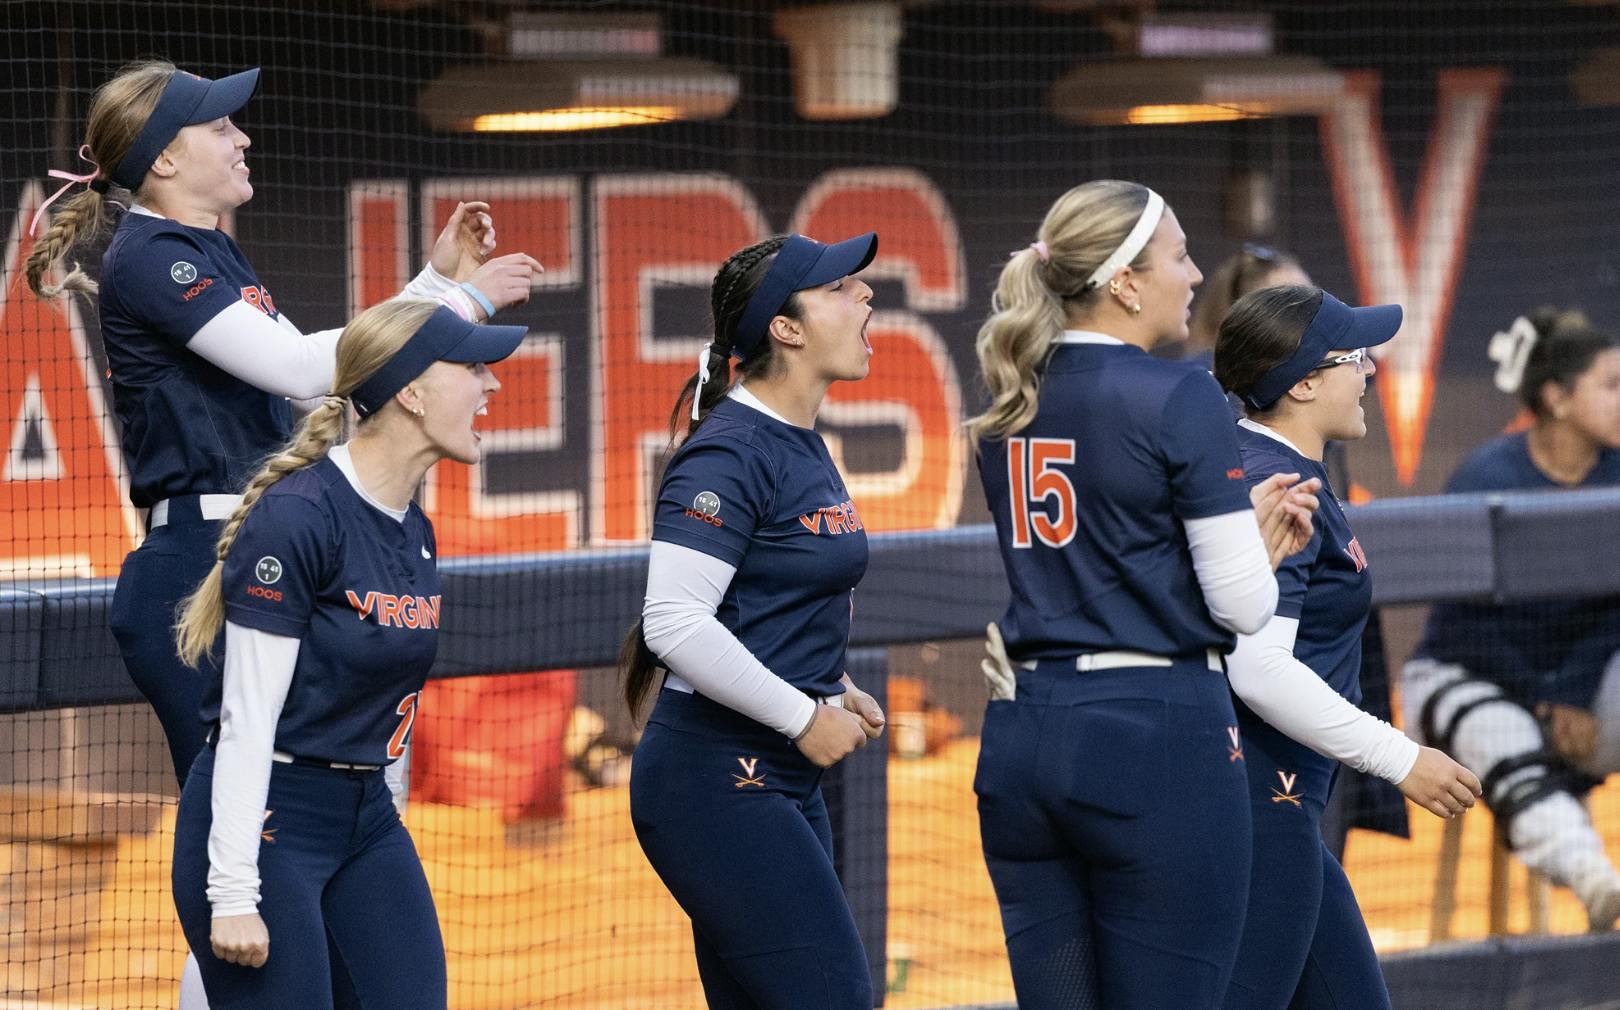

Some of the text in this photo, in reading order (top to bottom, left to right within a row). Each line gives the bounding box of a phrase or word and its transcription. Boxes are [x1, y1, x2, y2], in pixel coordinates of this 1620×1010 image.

[182, 278, 214, 301] HOOS
[1008, 437, 1078, 549] 15
[685, 507, 723, 527] HOOS
[247, 585, 282, 601] HOOS
[387, 690, 421, 759] 2
